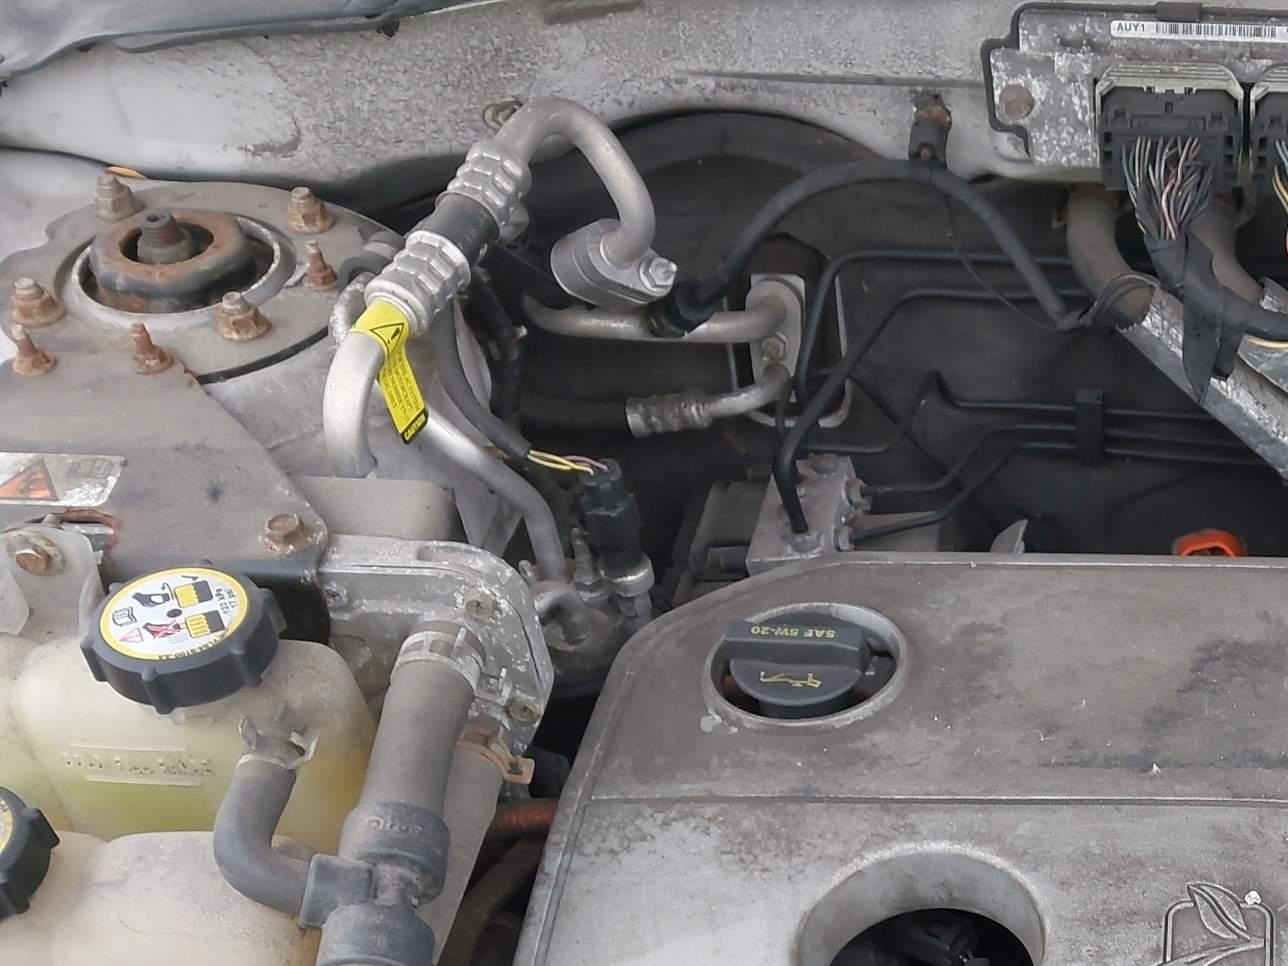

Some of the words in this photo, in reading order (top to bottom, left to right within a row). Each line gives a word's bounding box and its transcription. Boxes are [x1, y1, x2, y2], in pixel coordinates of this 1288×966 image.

[1116, 23, 1145, 32] AUY1
[750, 625, 799, 637] 5W-20
[803, 628, 836, 639] SAE
